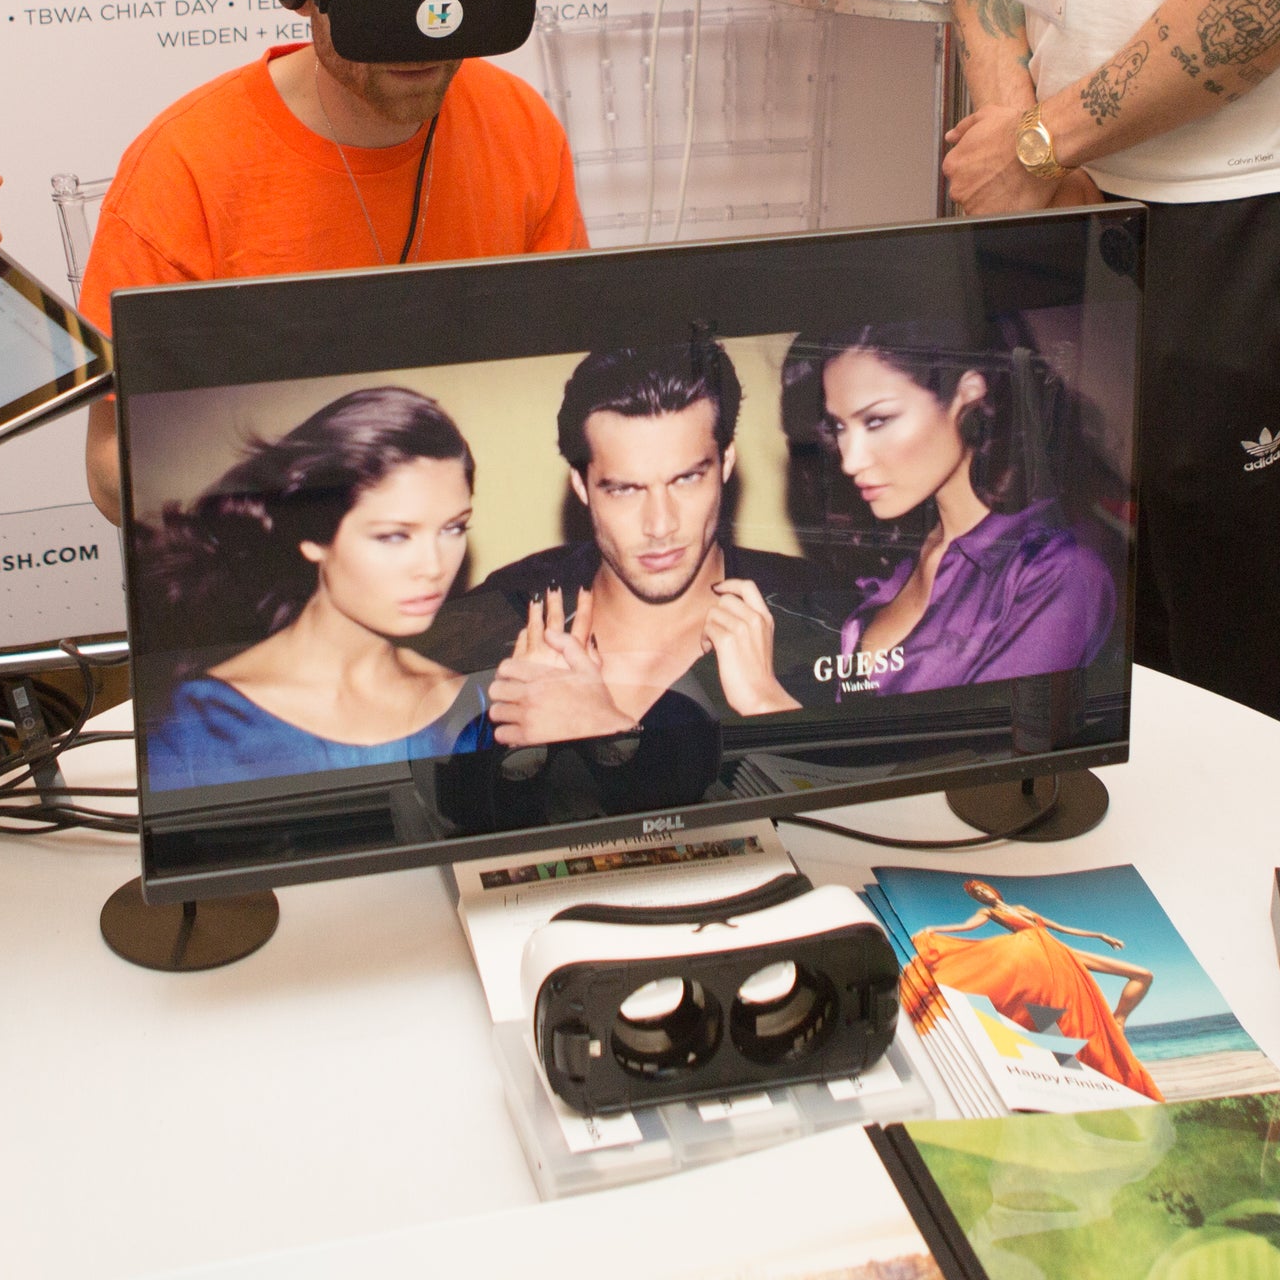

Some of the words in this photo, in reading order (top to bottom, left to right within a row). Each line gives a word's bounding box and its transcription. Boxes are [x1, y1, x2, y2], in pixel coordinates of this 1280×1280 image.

[23, 5, 93, 25] TBWA
[99, 0, 166, 21] CHIAT
[156, 26, 248, 48] WIEDEN
[255, 25, 268, 39] +
[813, 646, 905, 682] GUESS
[841, 679, 880, 693] Watches
[642, 815, 685, 834] DELL
[1006, 1064, 1061, 1085] Happy
